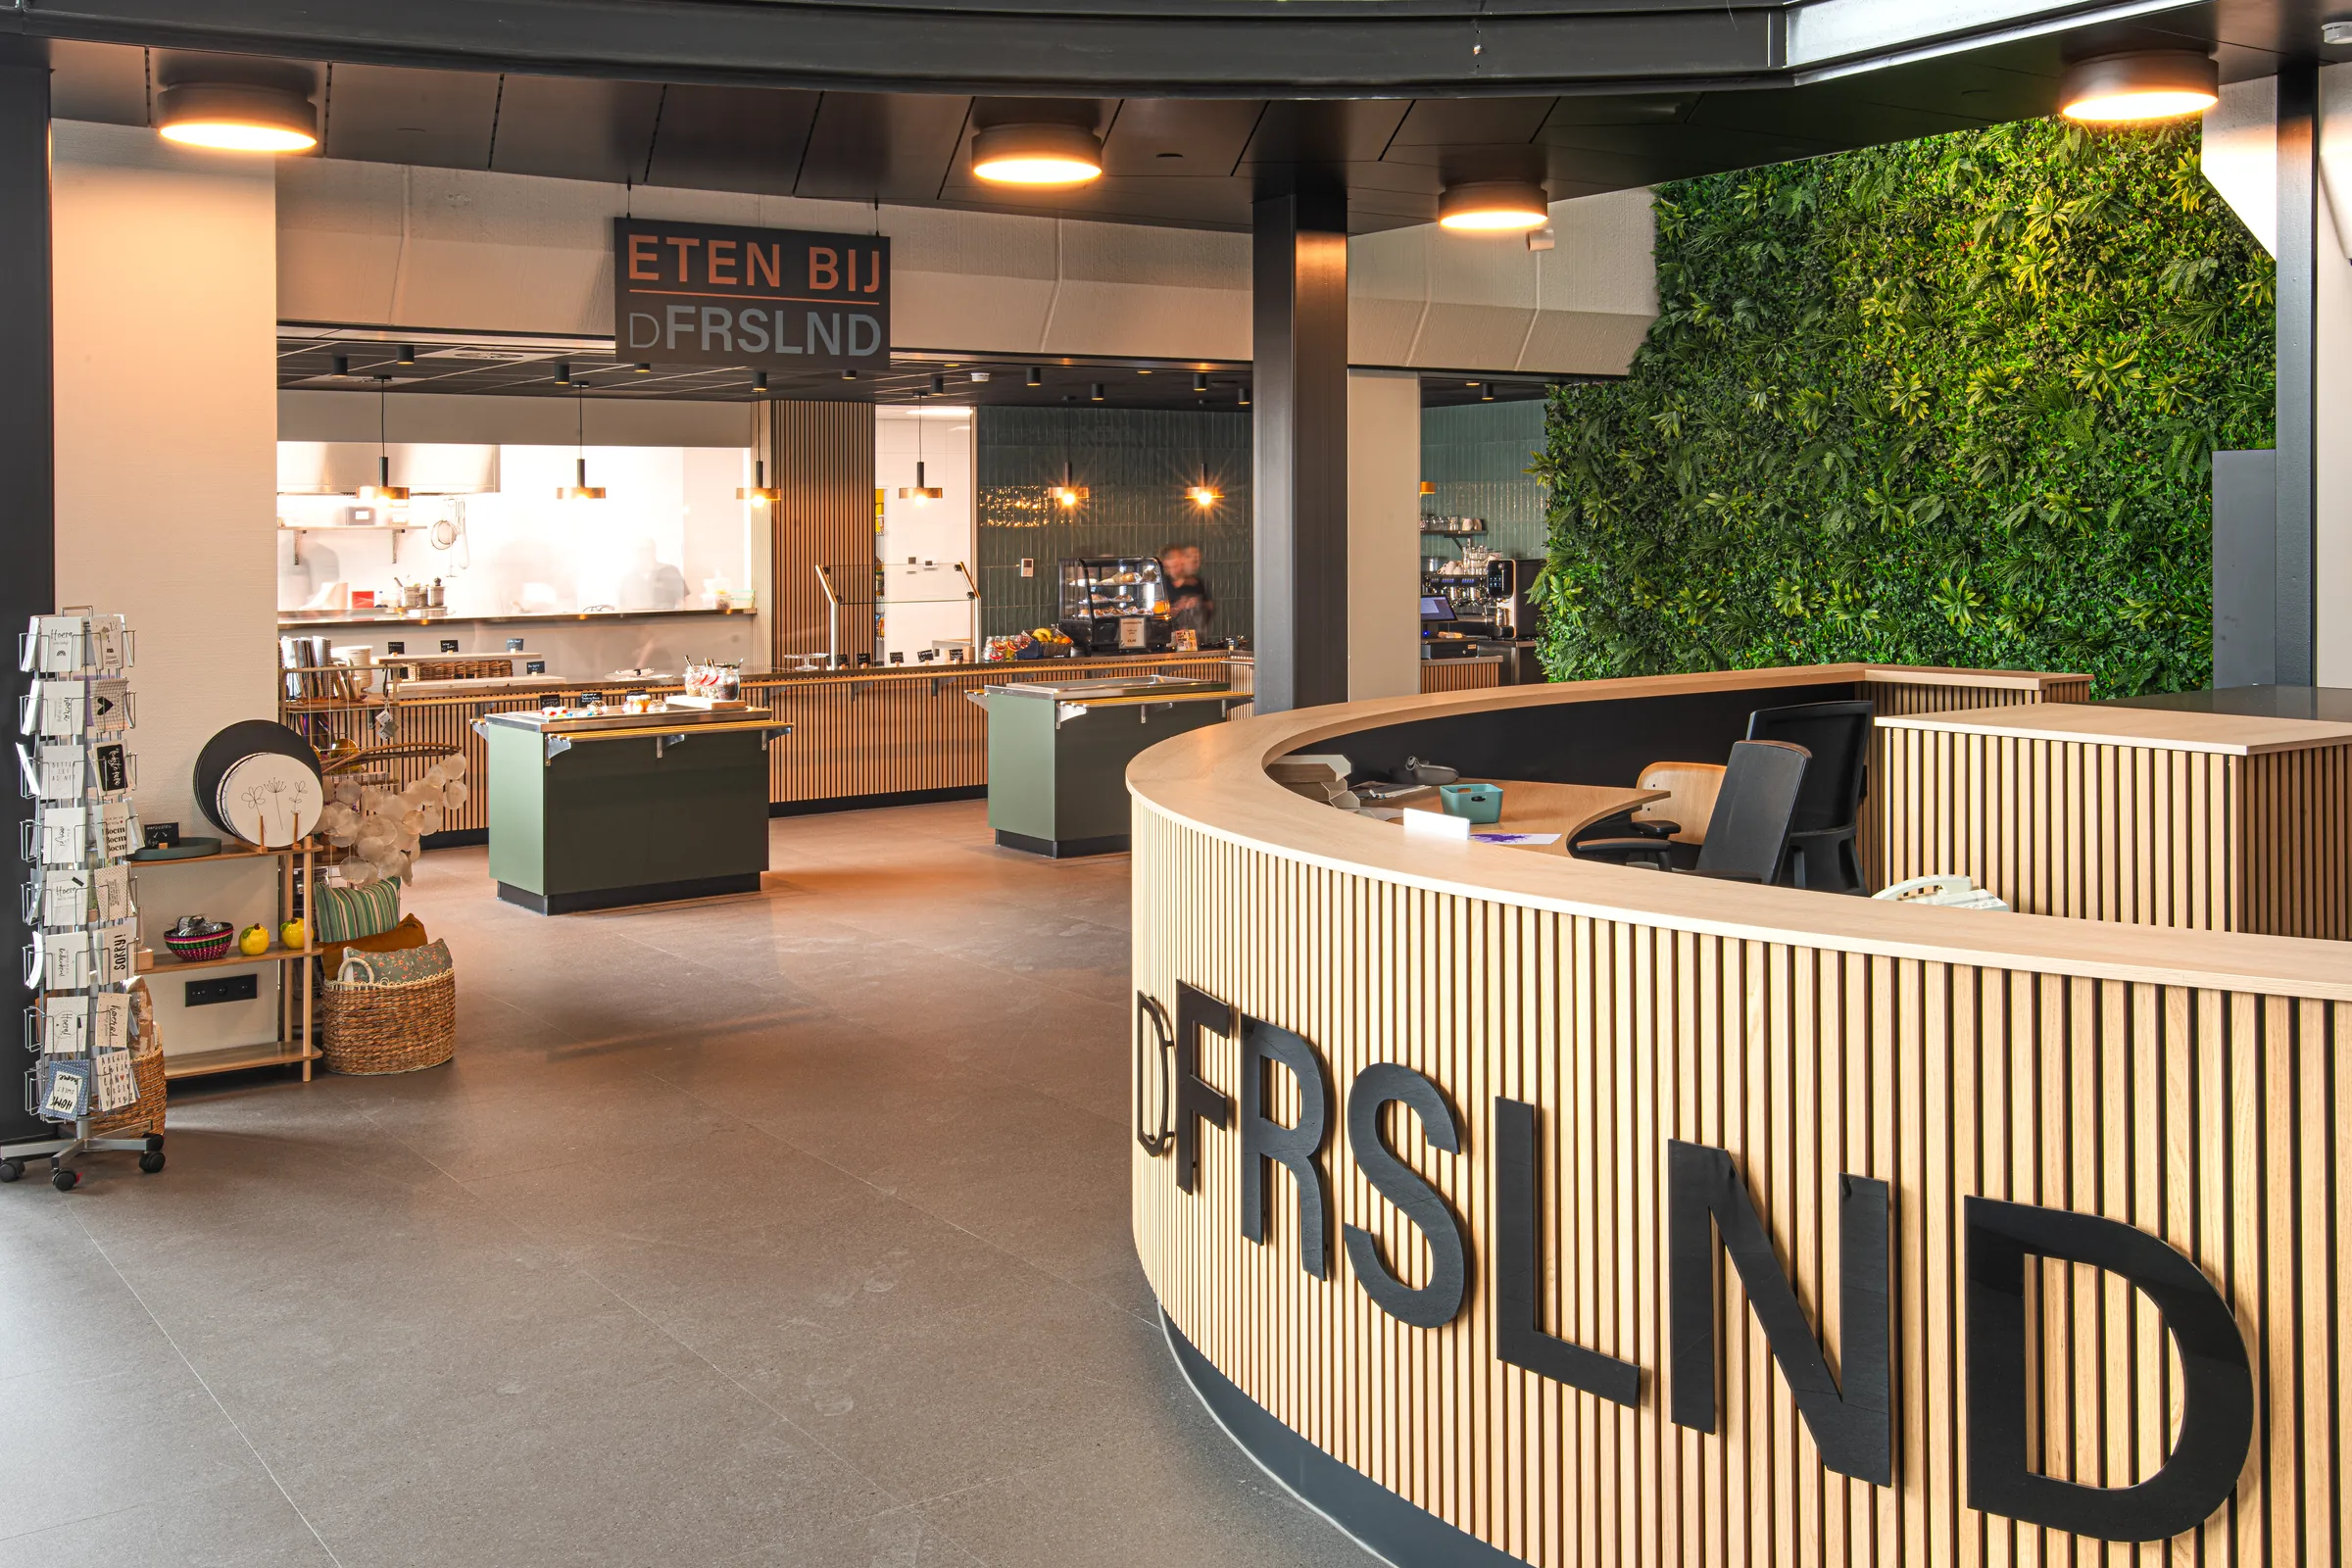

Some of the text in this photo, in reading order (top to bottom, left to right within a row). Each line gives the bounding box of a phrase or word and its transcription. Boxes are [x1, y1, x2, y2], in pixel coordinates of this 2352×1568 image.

[628, 234, 880, 293] ETEN BIJ
[629, 305, 881, 357] DFRSLND
[114, 933, 126, 971] SORRY!
[1138, 979, 2254, 1543] DFRSLND
